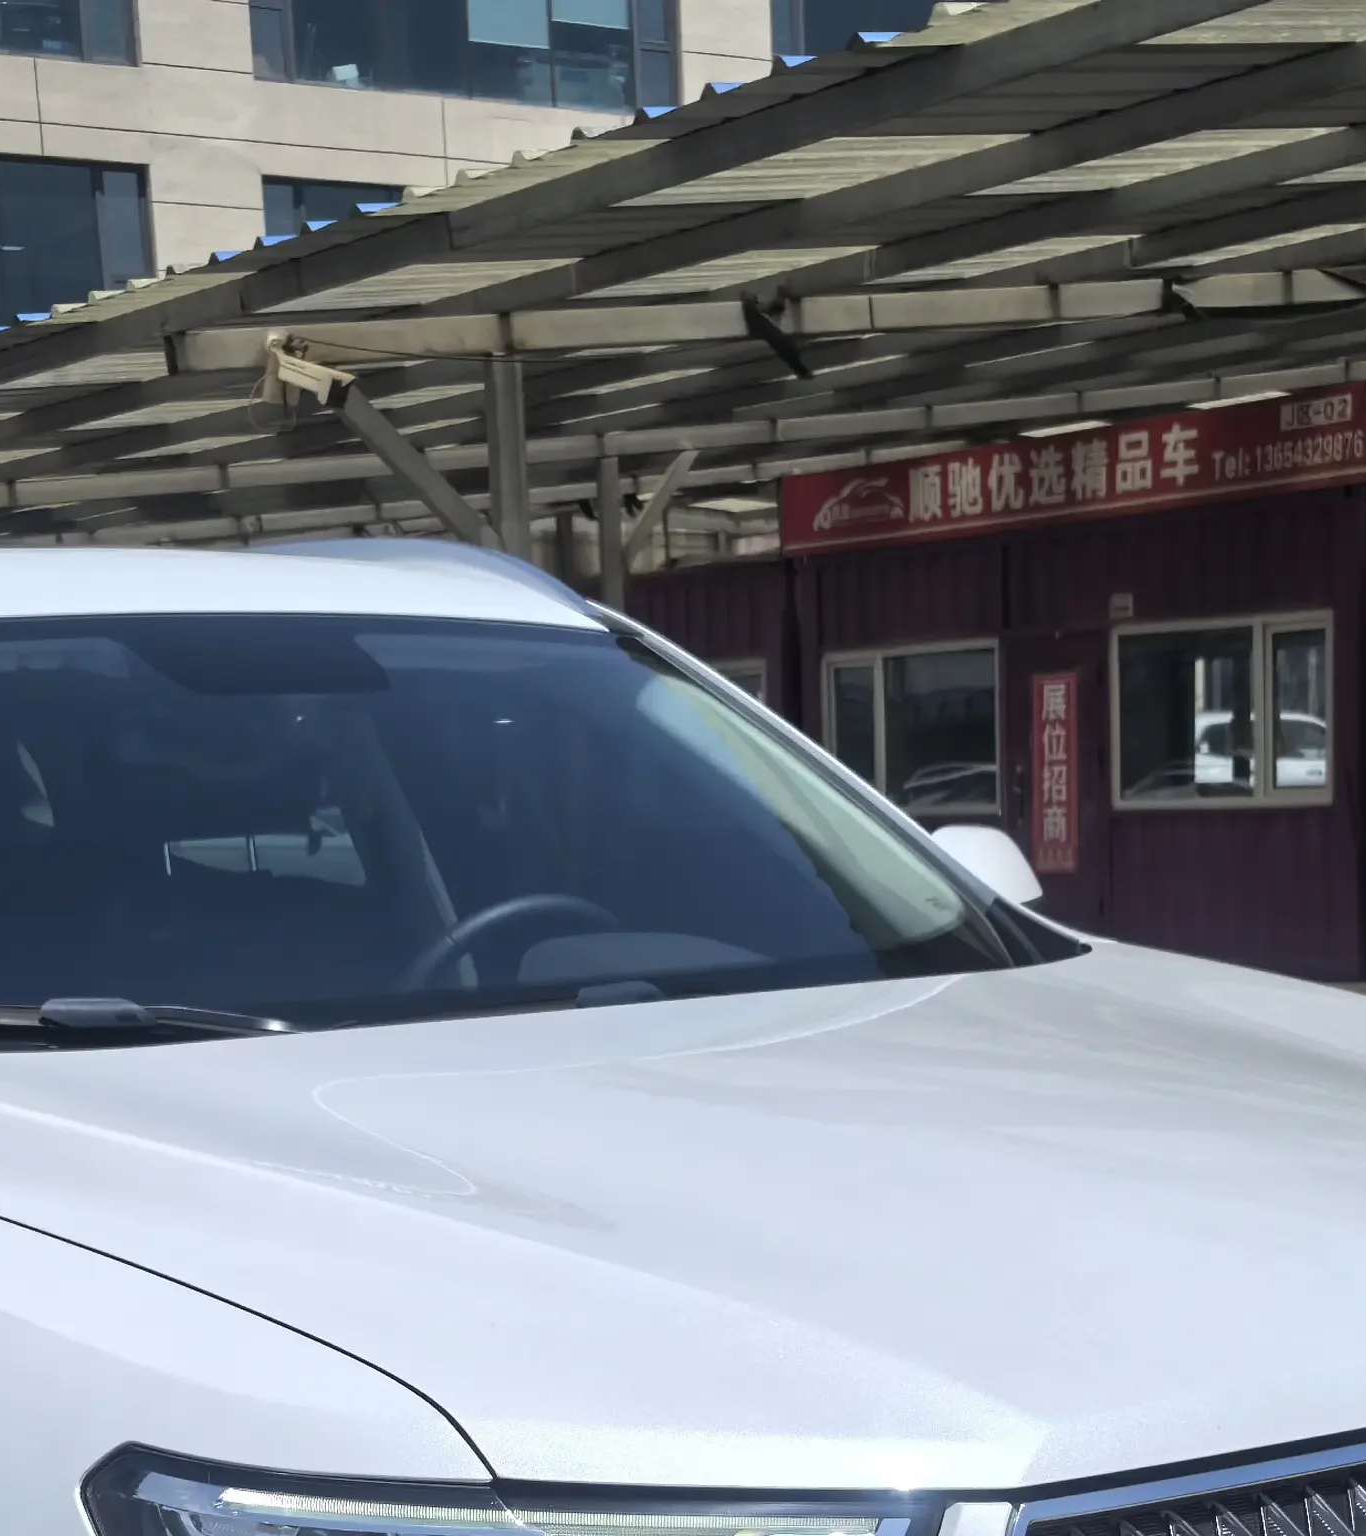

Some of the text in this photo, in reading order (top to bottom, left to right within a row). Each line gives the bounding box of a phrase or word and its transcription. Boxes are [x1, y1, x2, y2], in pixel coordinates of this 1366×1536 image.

[908, 422, 1199, 523] 顺驰优选精品车
[1041, 683, 1067, 843] 展位招商
